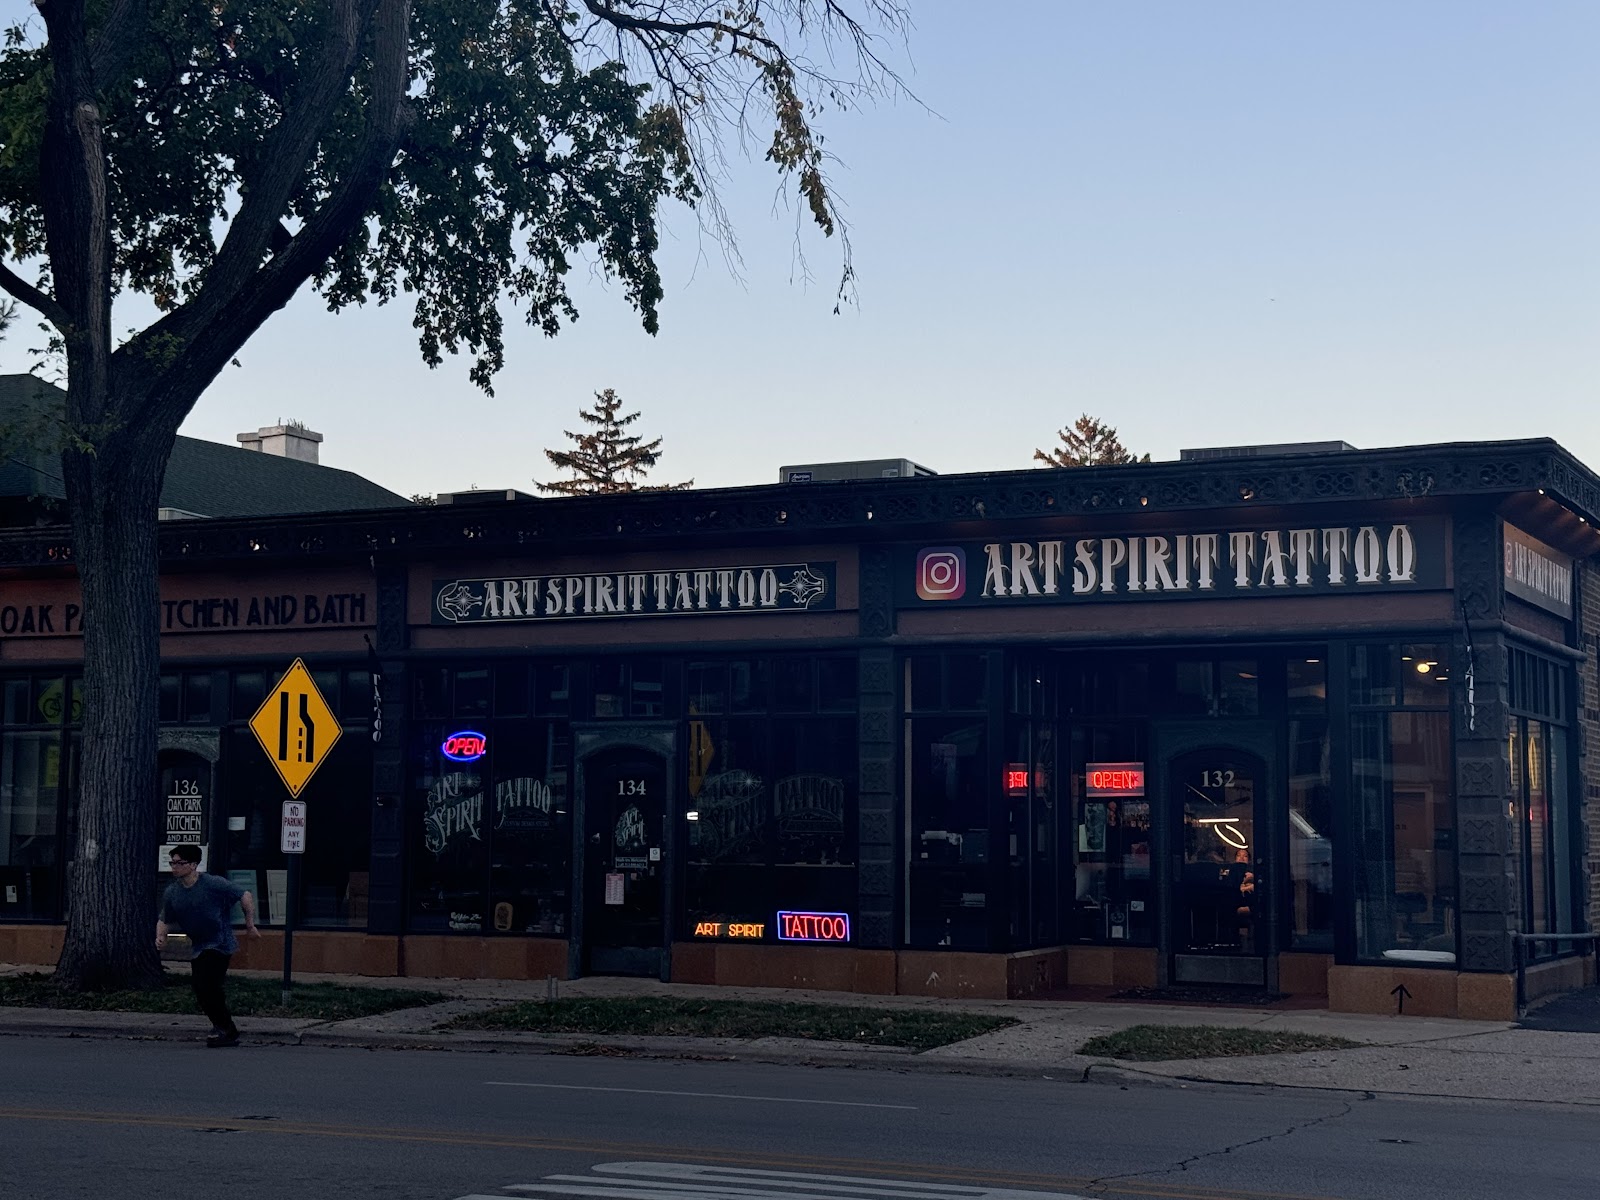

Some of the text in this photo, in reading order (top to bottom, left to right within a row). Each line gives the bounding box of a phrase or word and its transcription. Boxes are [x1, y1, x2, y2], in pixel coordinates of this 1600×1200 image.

[980, 524, 1417, 598] ART SPIRIT TATTOO
[482, 568, 779, 618] ART SPIRIT TATTOO
[1, 605, 54, 634] OAK
[162, 598, 239, 629] TCHEN
[246, 595, 298, 626] AND
[304, 593, 366, 624] BATH
[445, 737, 486, 755] OPEN
[175, 779, 199, 795] 136
[427, 772, 463, 803] ART
[618, 779, 647, 796] 134
[1094, 770, 1133, 789] OPEN
[1201, 770, 1235, 788] 132
[167, 798, 202, 811] OAK PARK
[290, 805, 299, 816] NO
[494, 777, 551, 829] TATTOO
[166, 815, 202, 831] KITCHEN
[284, 817, 304, 827] PARKING
[424, 791, 484, 853] SPIRIT
[167, 834, 200, 842] AND BATH
[287, 840, 300, 848] TIME
[695, 922, 765, 937] ART SPIRIT
[781, 914, 846, 939] TATTOO
